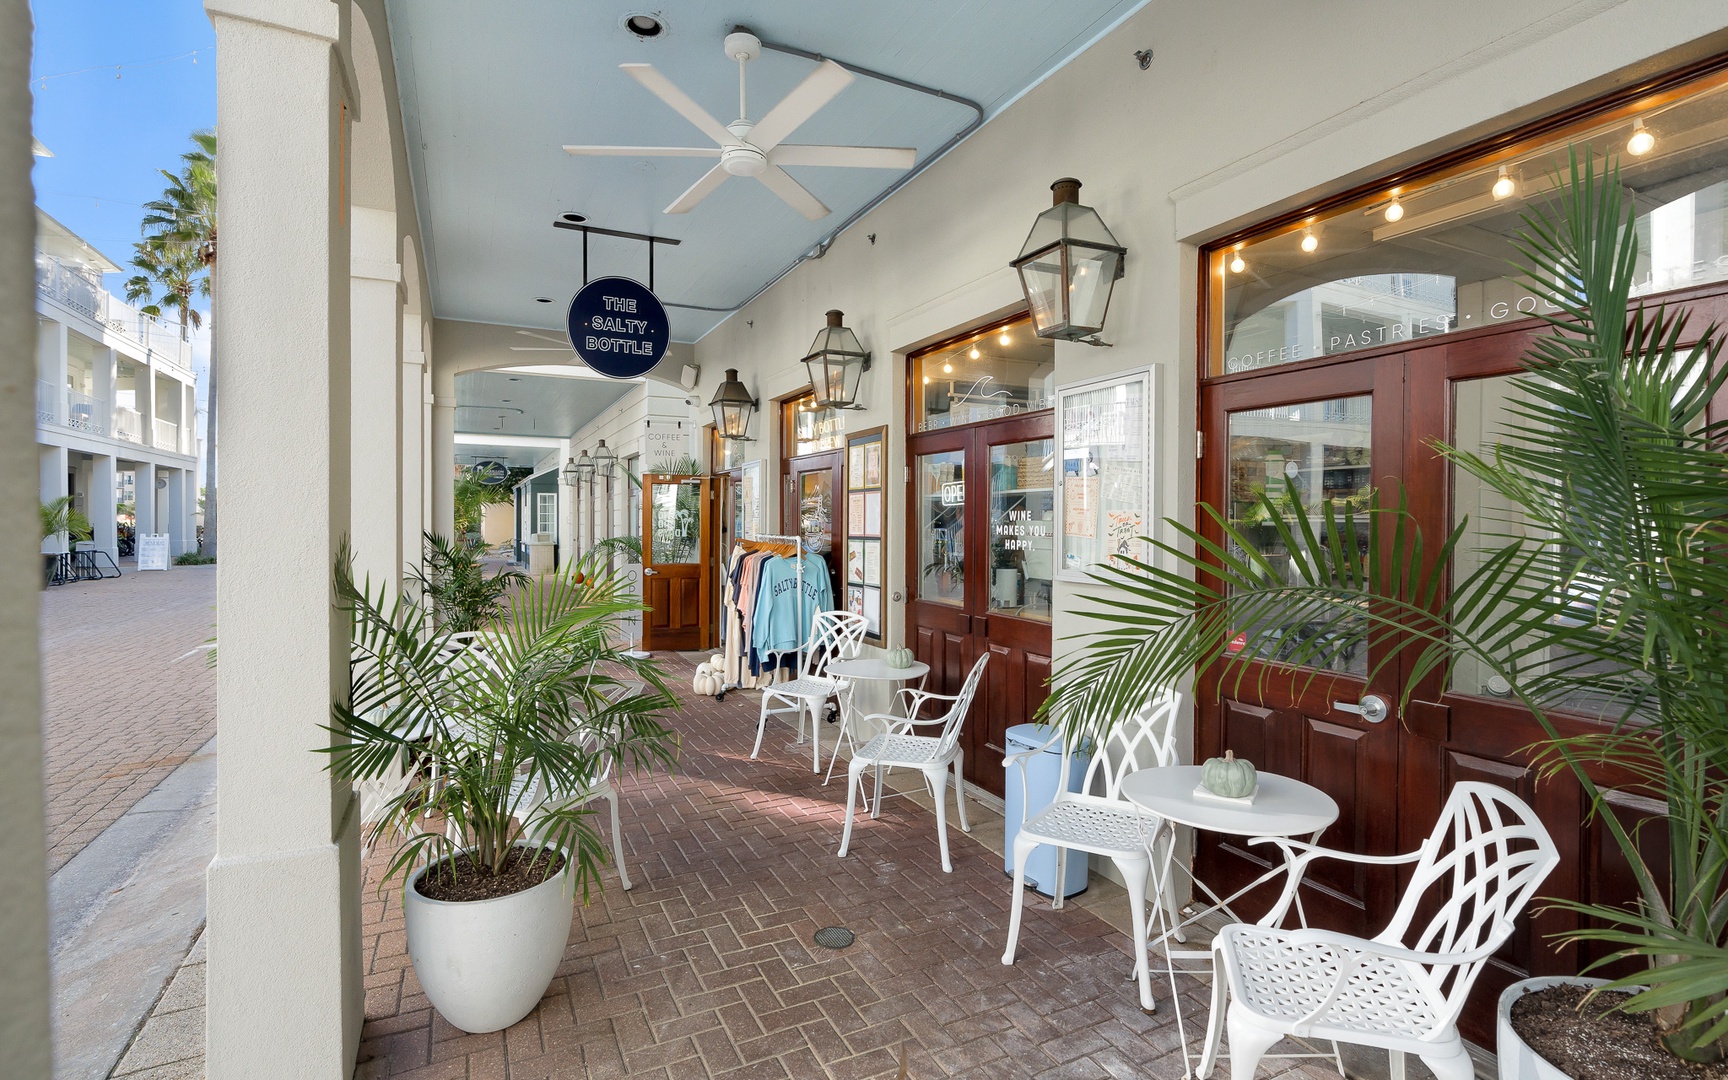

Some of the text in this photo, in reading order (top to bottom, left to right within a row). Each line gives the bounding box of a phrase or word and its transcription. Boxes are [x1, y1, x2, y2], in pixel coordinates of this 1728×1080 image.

[602, 295, 637, 313] THE
[591, 315, 648, 334] SALTY
[585, 335, 653, 356] BOTTLE
[1227, 343, 1303, 371] COFFEE
[1330, 313, 1449, 351] PASTRIES
[987, 403, 1020, 419] GOOD
[648, 433, 681, 441] COFFEE
[654, 449, 676, 457] WINE
[1008, 510, 1032, 522] WINE
[996, 524, 1046, 537] MAKES YOU
[1004, 539, 1035, 552] HAPPY.
[793, 577, 818, 600] BTTLE
[627, 570, 637, 626] OPN
